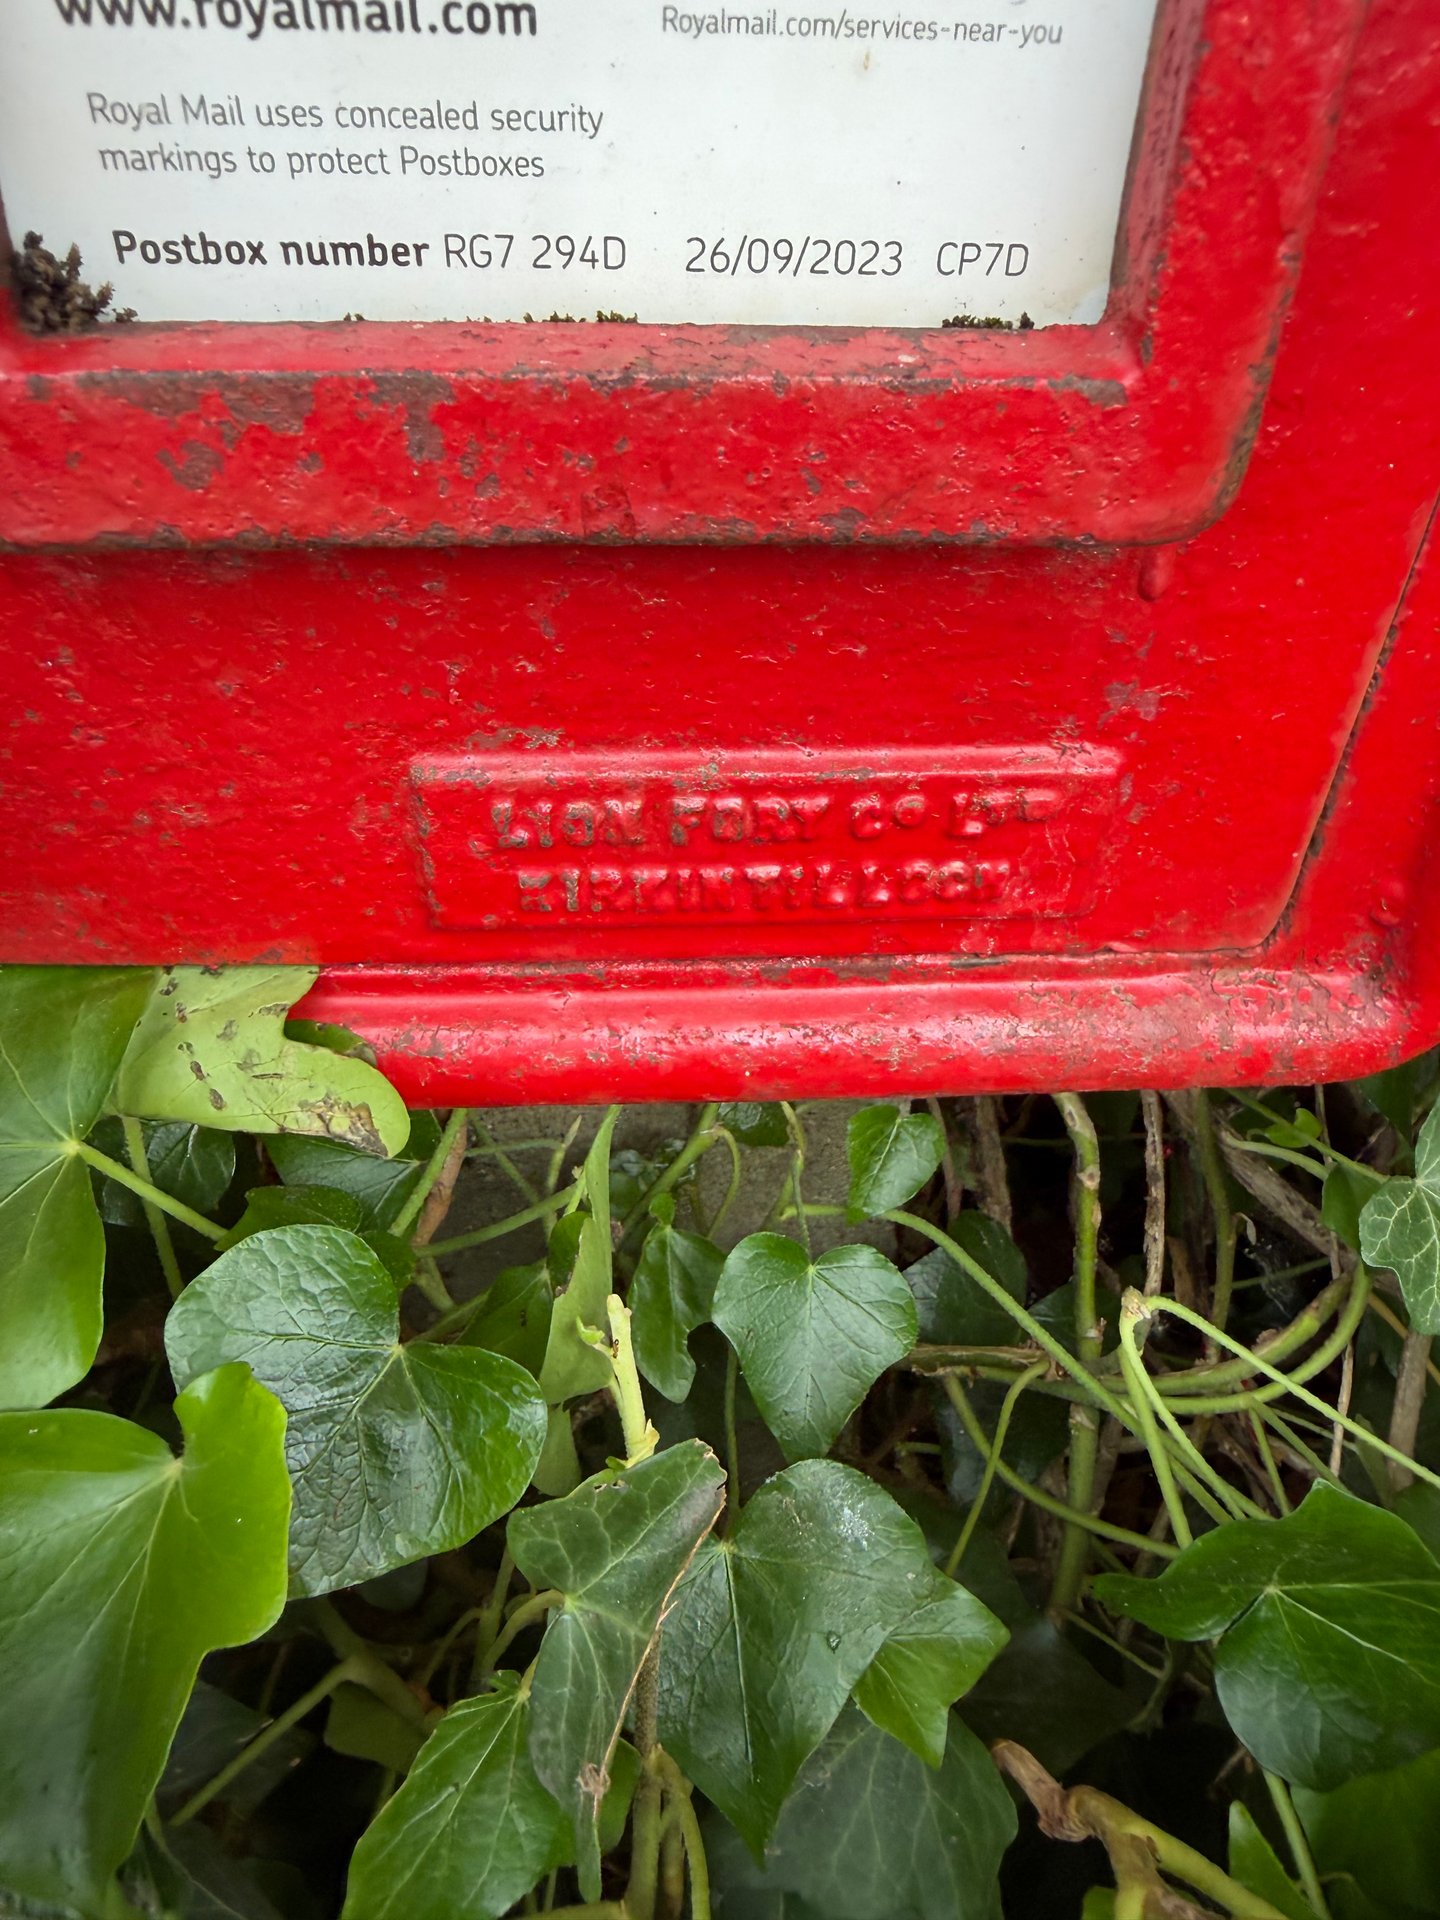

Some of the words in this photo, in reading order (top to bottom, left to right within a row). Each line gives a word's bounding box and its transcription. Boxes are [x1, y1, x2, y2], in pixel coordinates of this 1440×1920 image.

[55, 0, 538, 40] www.royalmail.com
[662, 5, 1063, 49] Royalmail.com/services-near-you
[86, 92, 170, 131] Royal
[180, 93, 246, 127] Mail
[255, 104, 324, 128] uses
[334, 99, 480, 131] concealed
[490, 102, 604, 140] security
[97, 141, 238, 180] markings
[246, 145, 276, 174] to
[286, 147, 391, 181] protect
[399, 144, 545, 178] Postboxes
[111, 229, 268, 266] Postbox
[278, 232, 430, 268] number
[443, 233, 515, 269] RG7
[531, 234, 626, 271] 294D
[685, 234, 903, 278] 26/09/2023
[936, 241, 1030, 277] CP7D
[491, 799, 645, 849] LION
